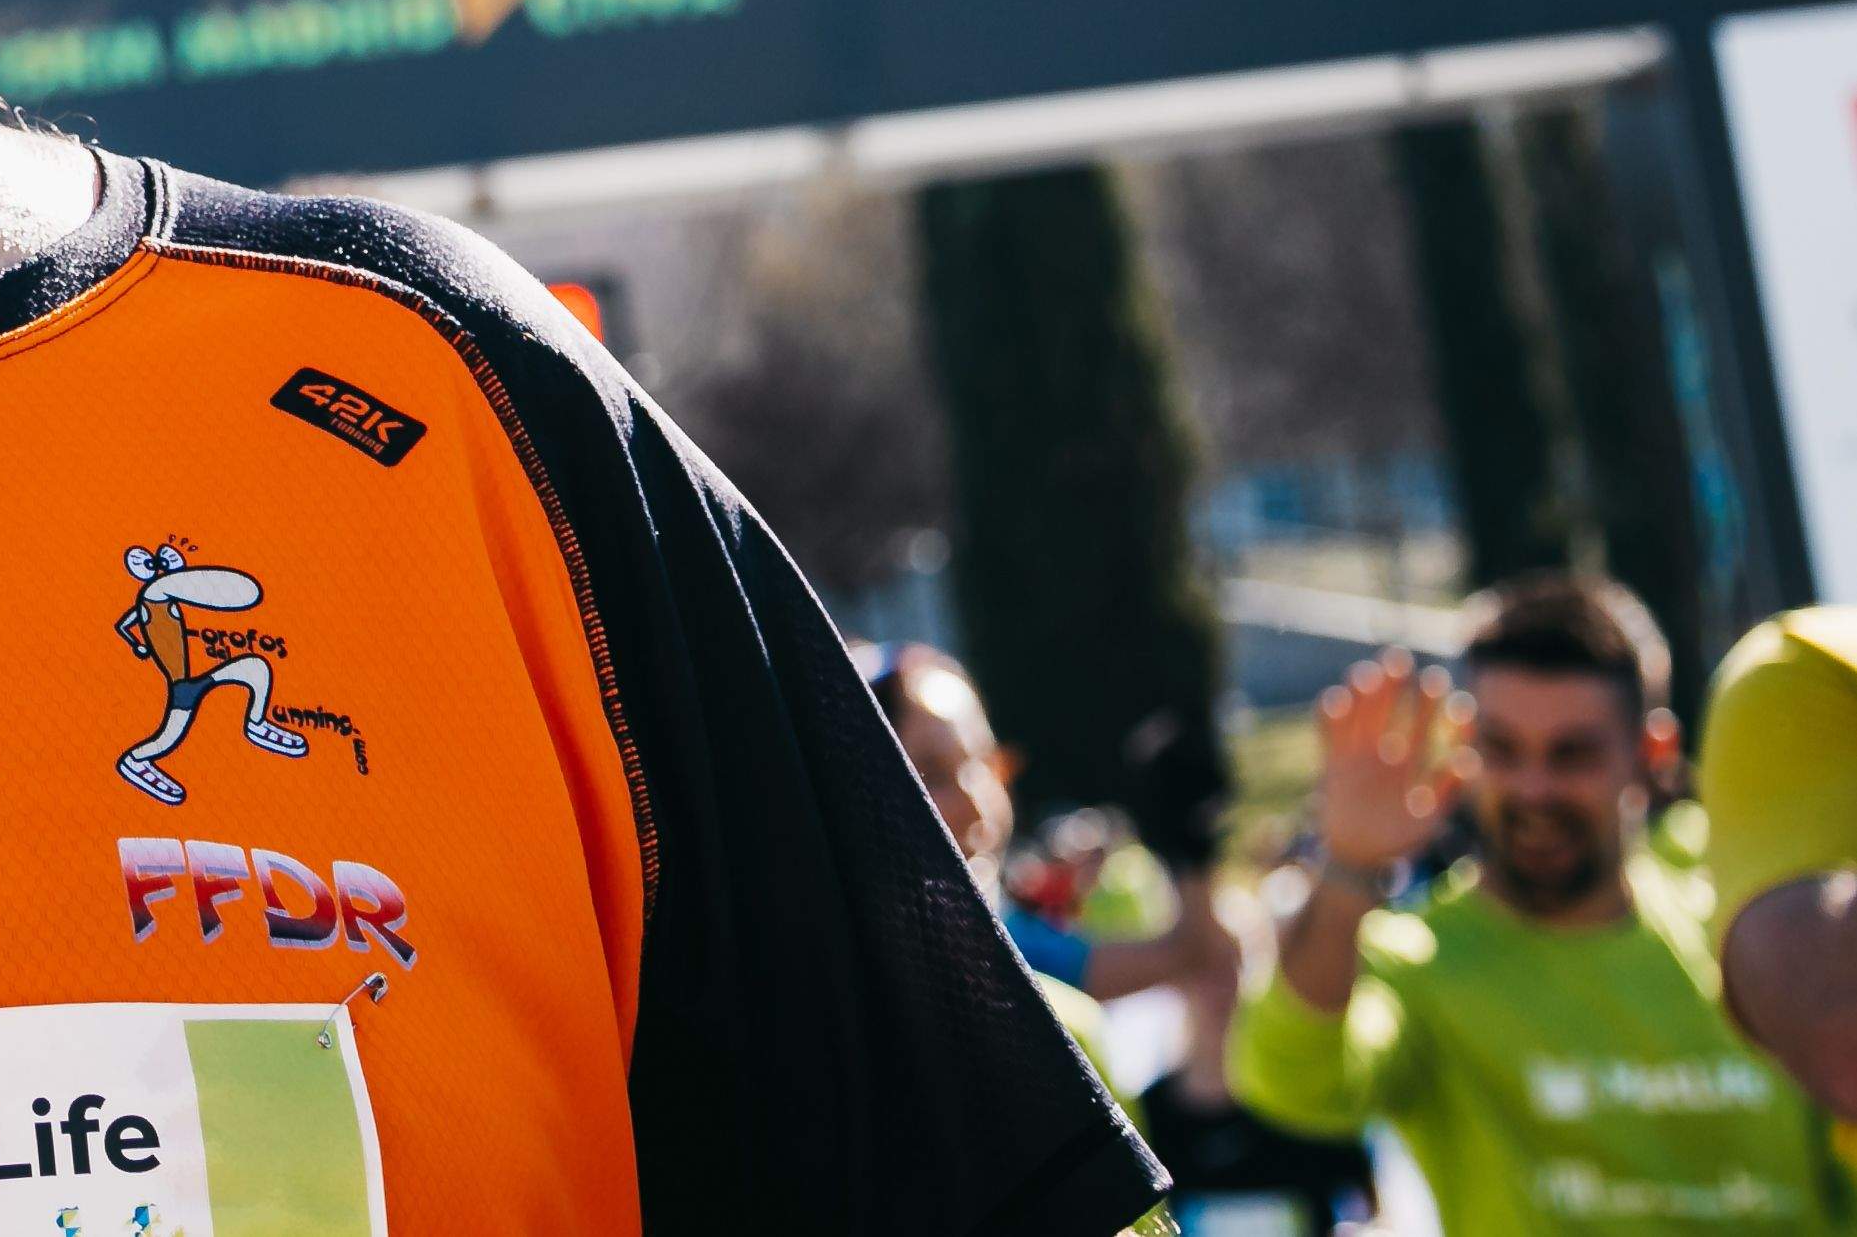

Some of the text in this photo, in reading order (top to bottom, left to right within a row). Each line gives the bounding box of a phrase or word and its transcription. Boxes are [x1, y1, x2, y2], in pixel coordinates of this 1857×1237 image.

[298, 384, 405, 444] 42K
[329, 417, 385, 455] running
[117, 836, 419, 972] FFDR
